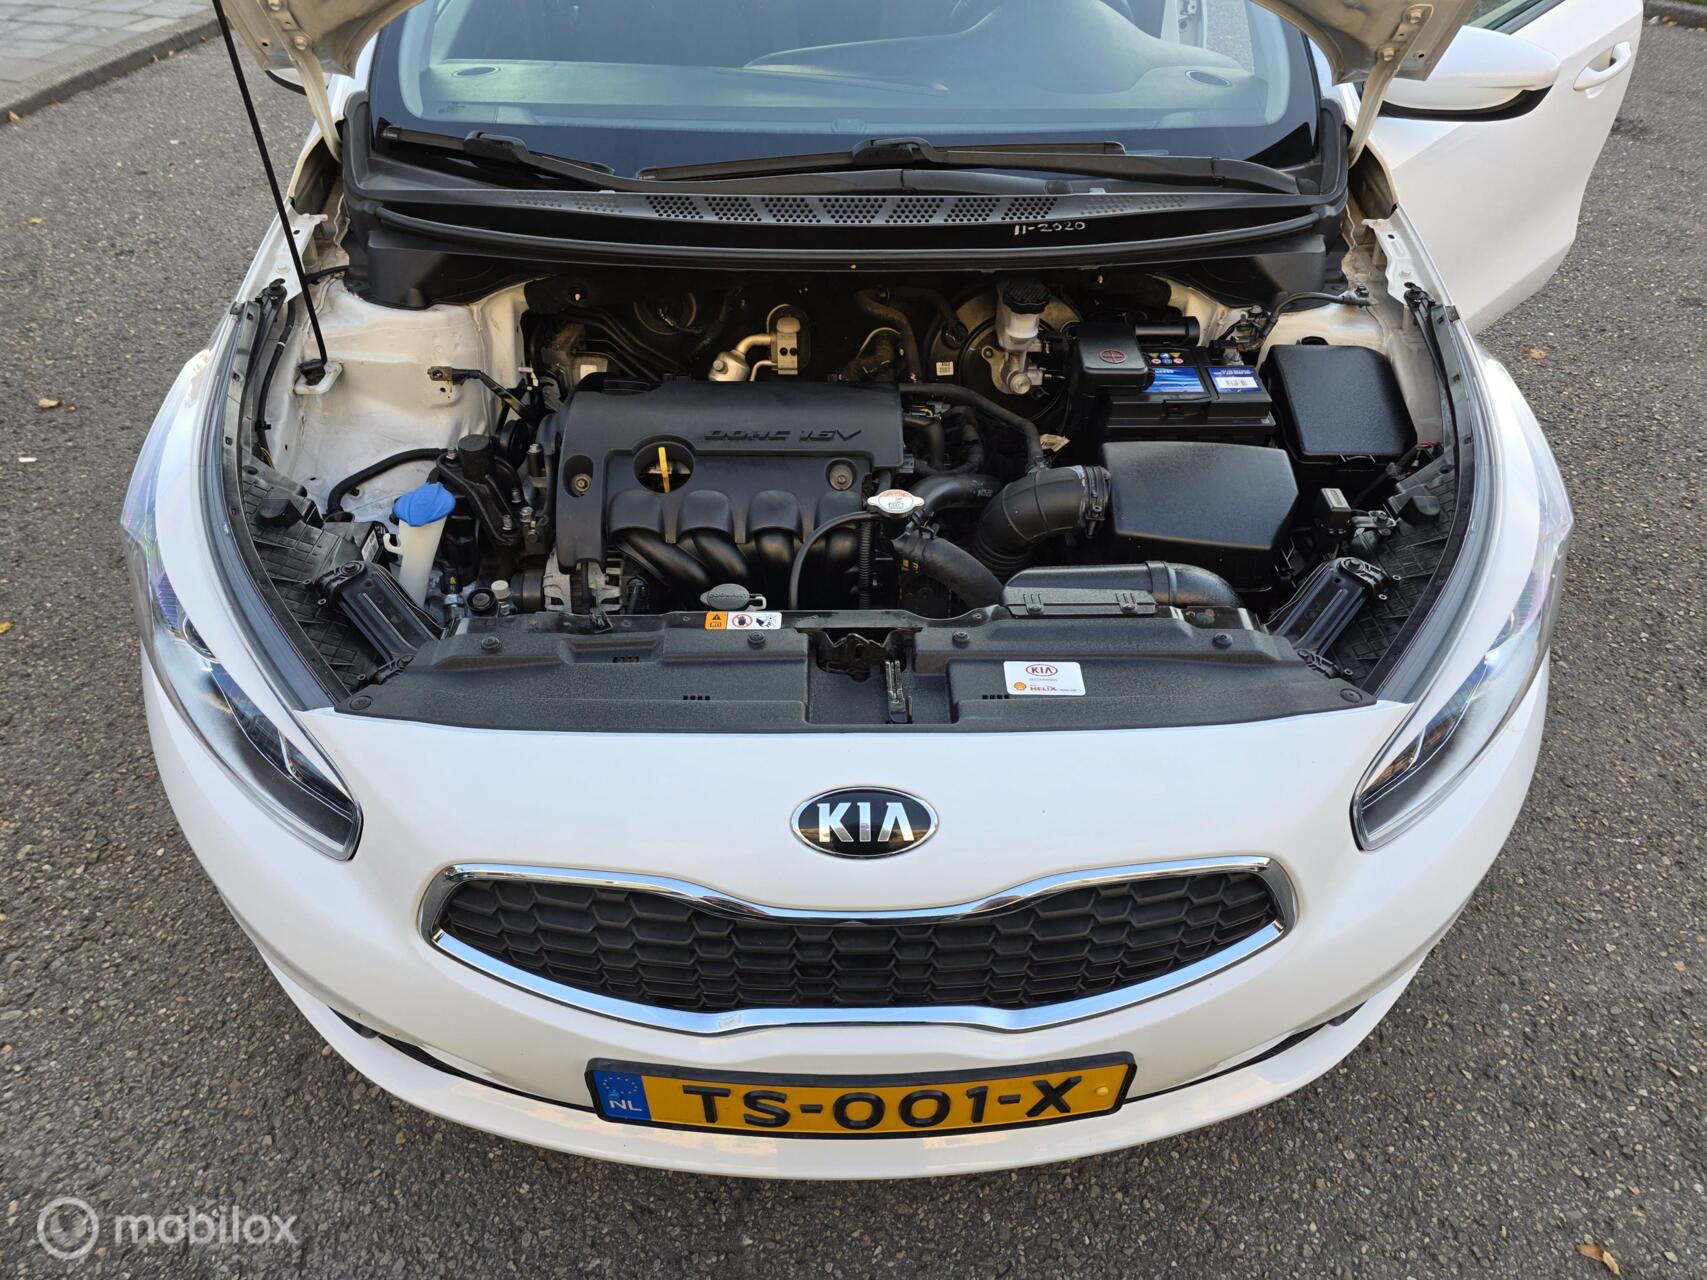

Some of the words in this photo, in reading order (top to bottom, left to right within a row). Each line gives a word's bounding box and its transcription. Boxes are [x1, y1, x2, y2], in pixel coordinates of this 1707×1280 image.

[1014, 221, 1086, 236] 11-2020
[1031, 666, 1053, 674] KIA
[817, 802, 915, 843] KIA
[608, 1098, 642, 1113] NL
[683, 1076, 1083, 1129] TS-001-X
